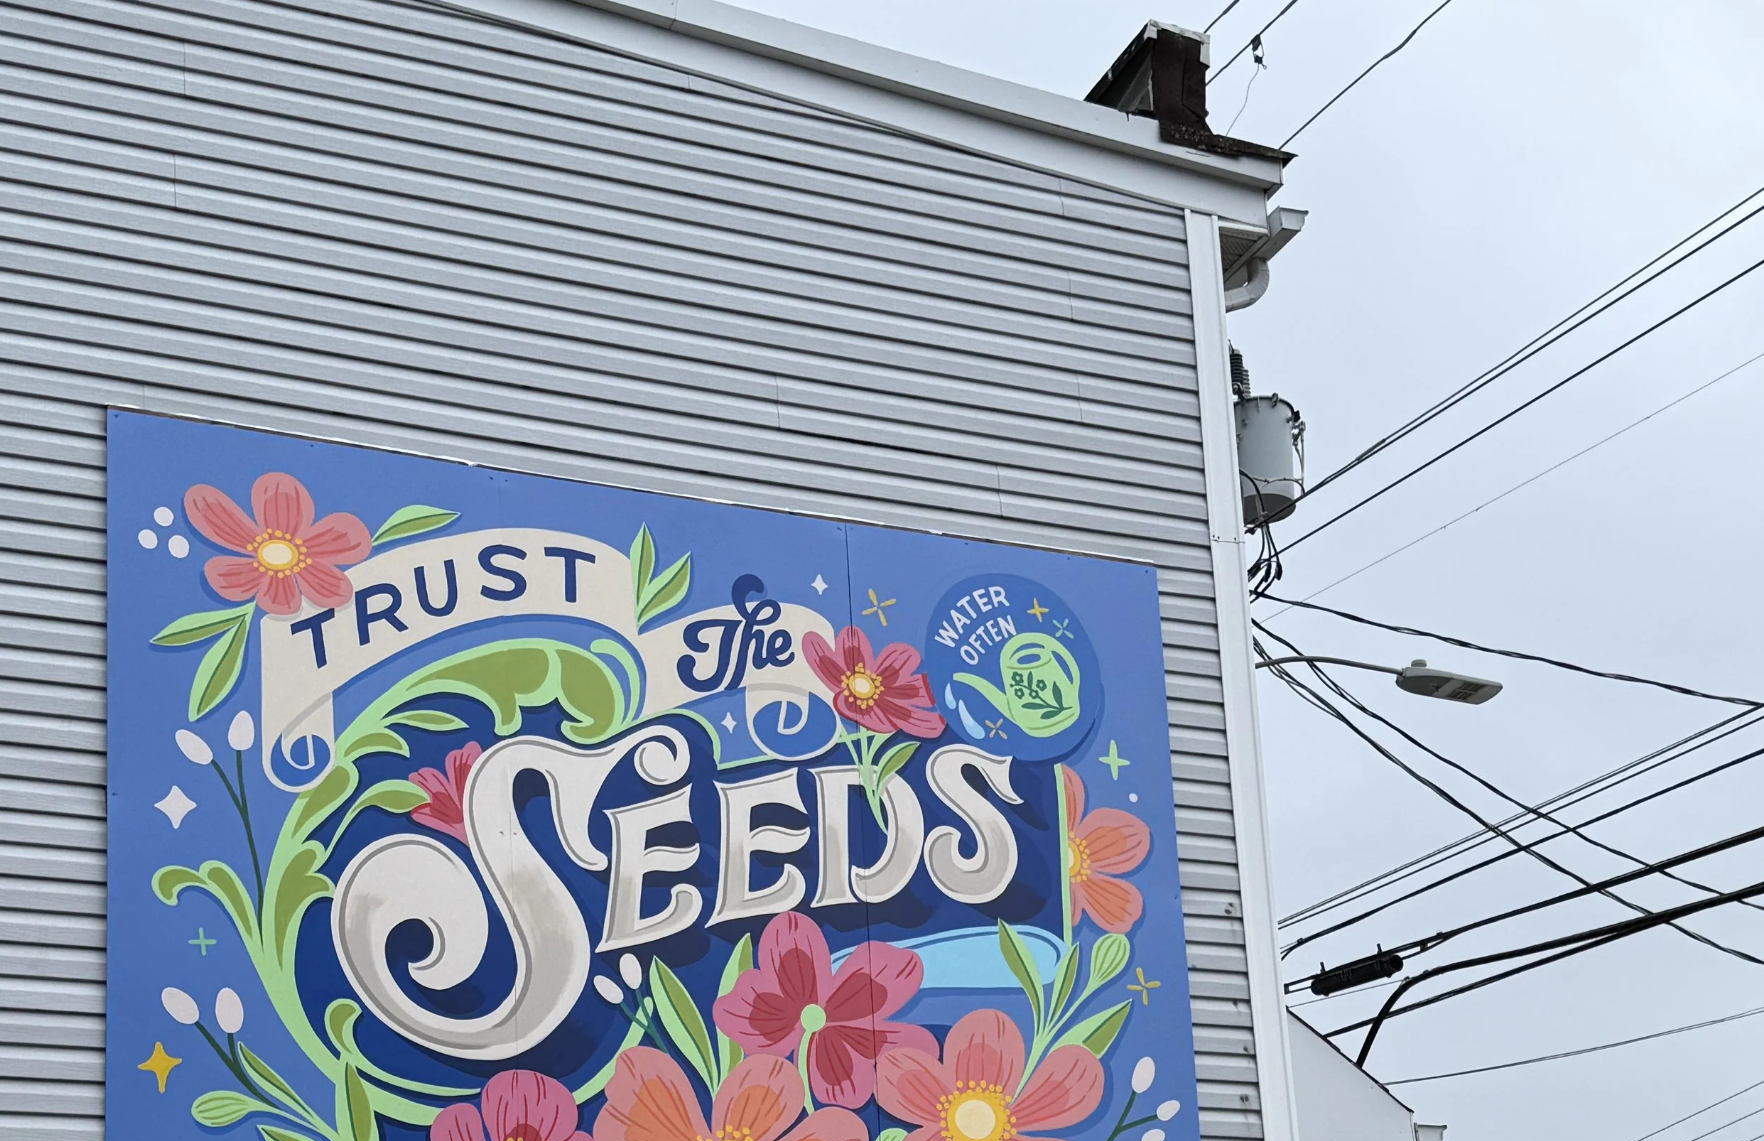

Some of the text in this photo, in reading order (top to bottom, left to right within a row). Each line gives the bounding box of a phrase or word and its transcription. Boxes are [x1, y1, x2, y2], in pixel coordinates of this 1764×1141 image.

[290, 544, 596, 670] TRUST
[676, 573, 796, 693] The
[934, 586, 1010, 648] WATER
[959, 615, 1017, 665] OFTEN
[330, 725, 1025, 1061] SEEDS
